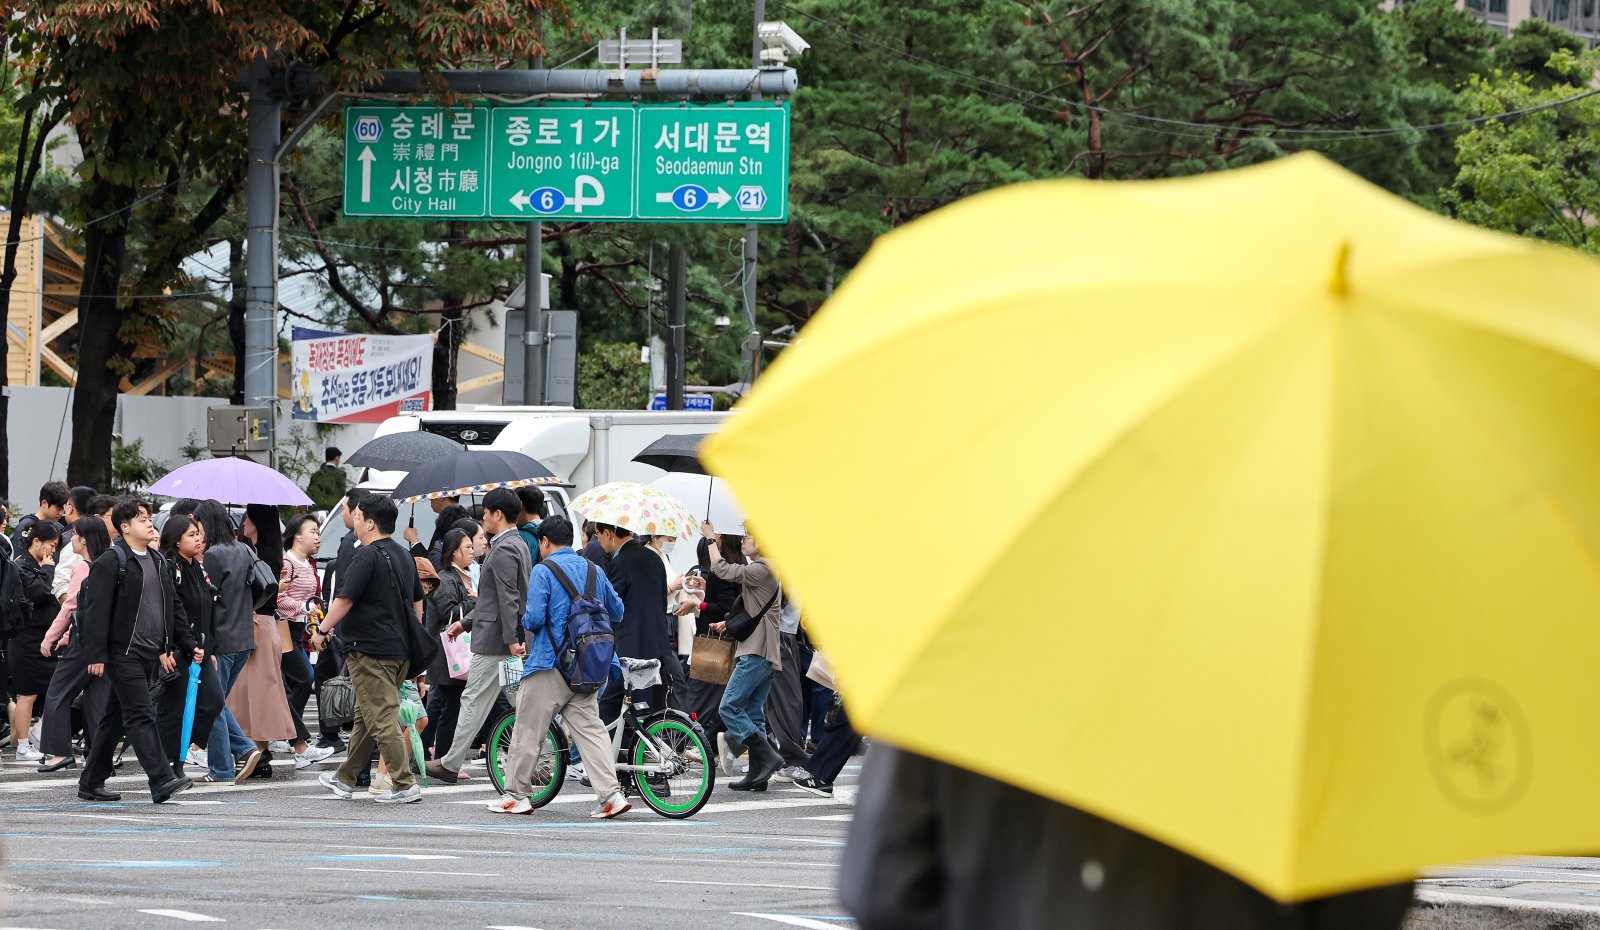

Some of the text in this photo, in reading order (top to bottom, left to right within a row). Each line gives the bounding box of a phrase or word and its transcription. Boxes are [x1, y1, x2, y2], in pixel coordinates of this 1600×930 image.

[360, 122, 377, 137] 60
[391, 112, 475, 140] 숭례문
[654, 122, 770, 153] 서대문역
[393, 143, 459, 161] 崇禮門
[508, 151, 619, 174] Jongno 1(il)-ga
[656, 156, 763, 175] Seodaemun Stn
[392, 196, 456, 213] City Hall
[541, 191, 554, 210] 6
[684, 189, 697, 208] 6
[742, 191, 760, 206] 21
[309, 340, 336, 373] 독재정권
[337, 337, 367, 368] 폭정에도
[321, 356, 422, 414] 추석만은 웃음 가득 보내세요!
